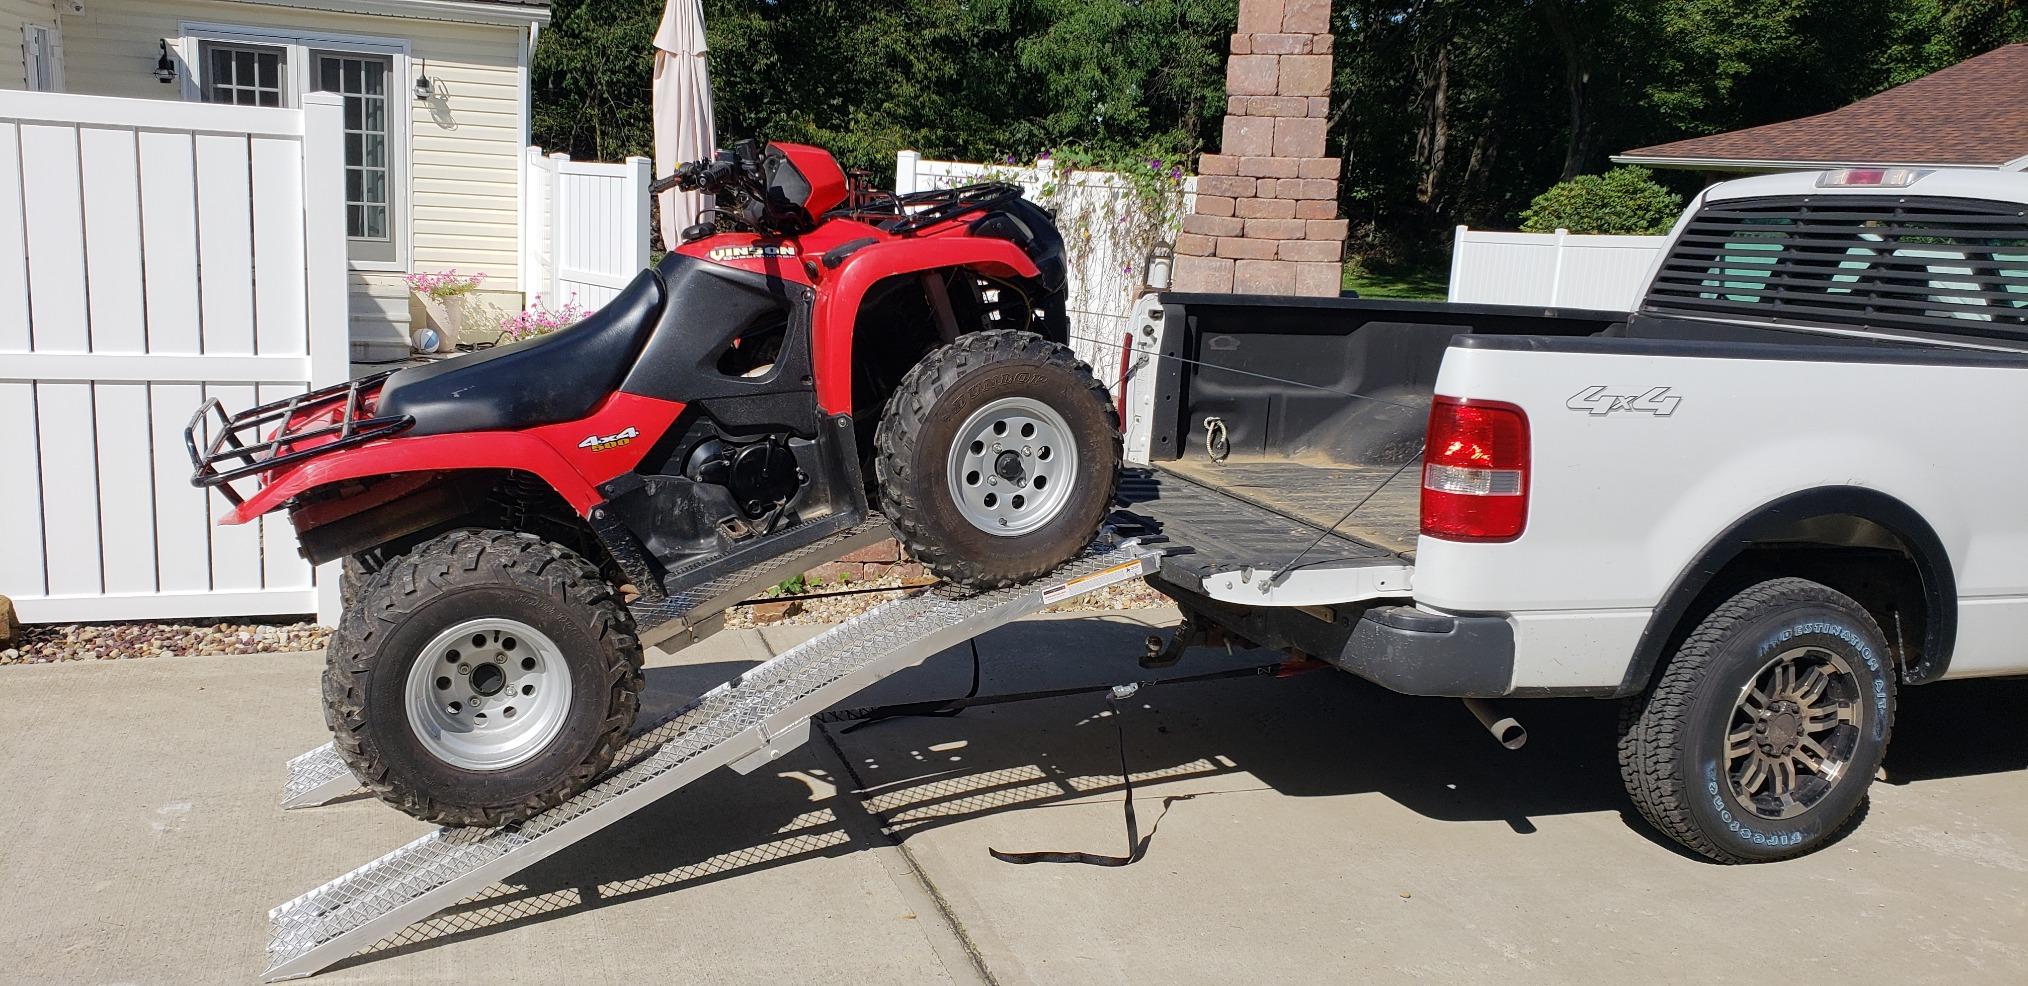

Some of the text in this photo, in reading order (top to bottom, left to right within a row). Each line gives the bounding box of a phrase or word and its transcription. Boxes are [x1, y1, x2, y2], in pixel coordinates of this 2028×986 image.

[709, 246, 795, 261] VINSON
[1566, 385, 1682, 416] 4x4
[578, 426, 640, 448] 4x4
[1782, 622, 1879, 671] DESTINATION
[1708, 781, 1802, 846] Firestone
